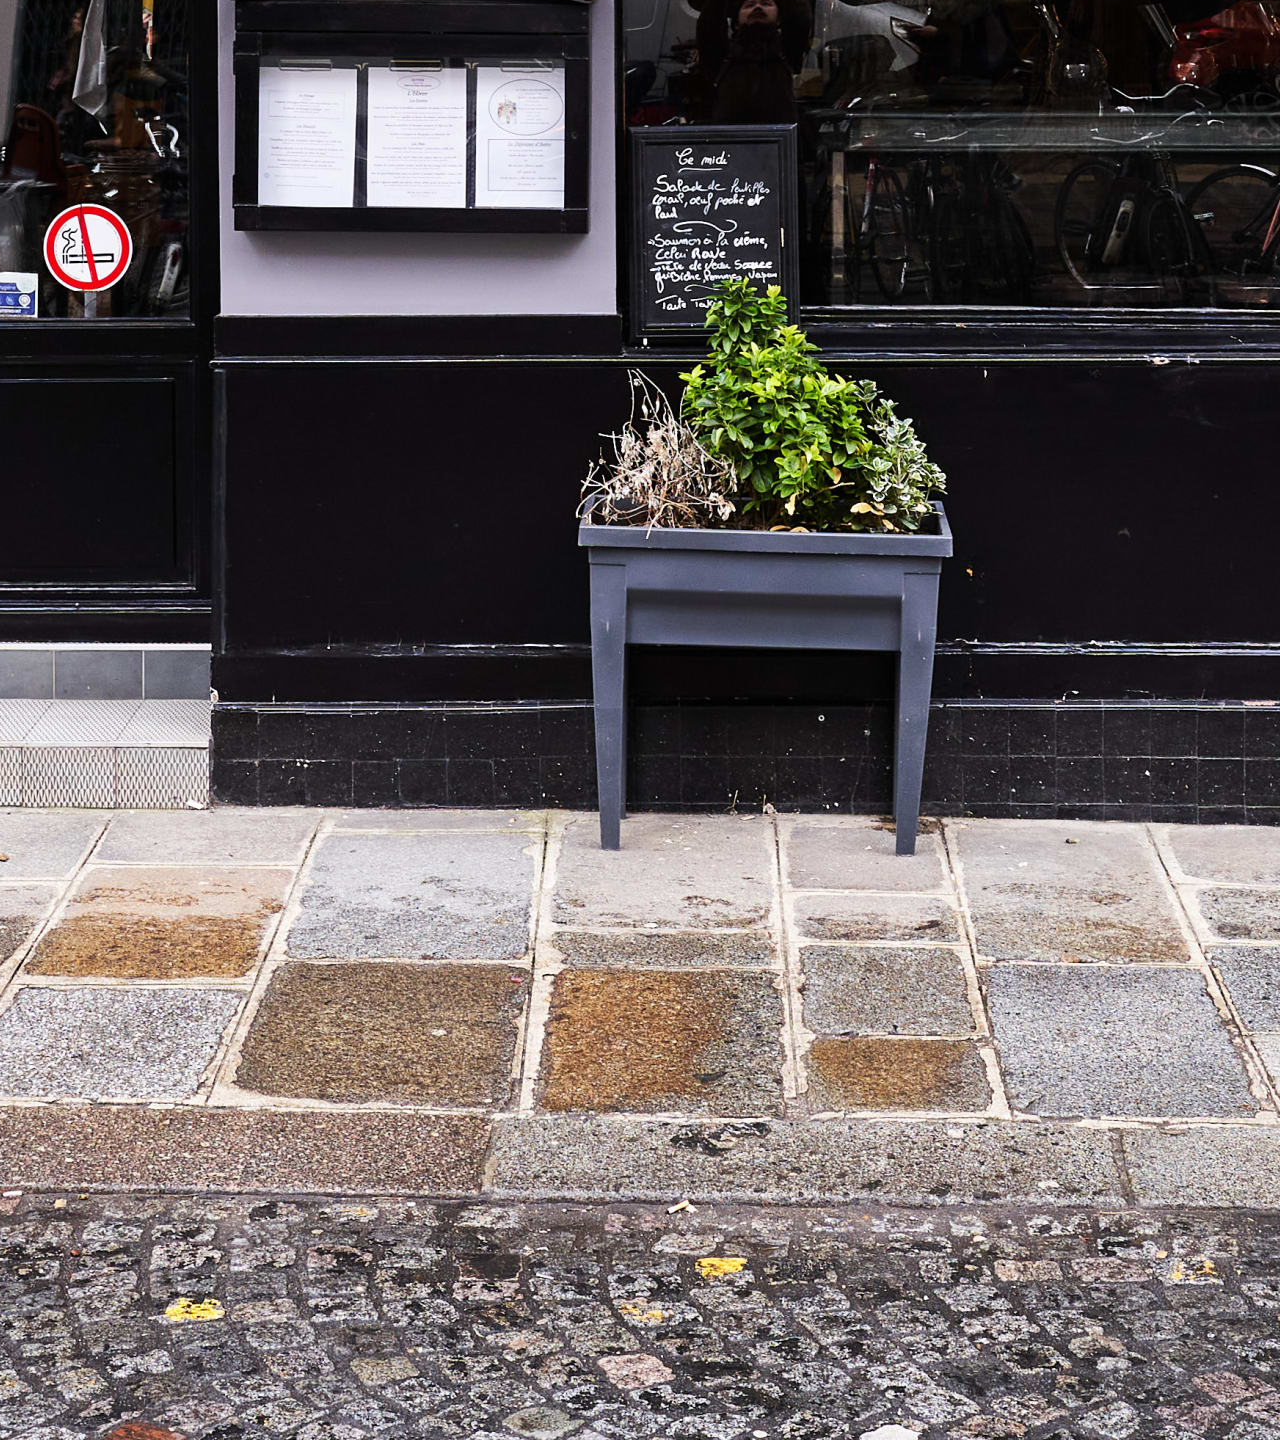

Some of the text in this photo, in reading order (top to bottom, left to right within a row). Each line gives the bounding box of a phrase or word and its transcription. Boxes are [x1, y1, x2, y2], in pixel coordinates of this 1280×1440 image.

[700, 150, 731, 166] midi
[653, 174, 708, 192] Salade
[654, 233, 701, 248] Saumon
[703, 232, 714, 246] à
[715, 230, 730, 247] la
[688, 260, 703, 271] de
